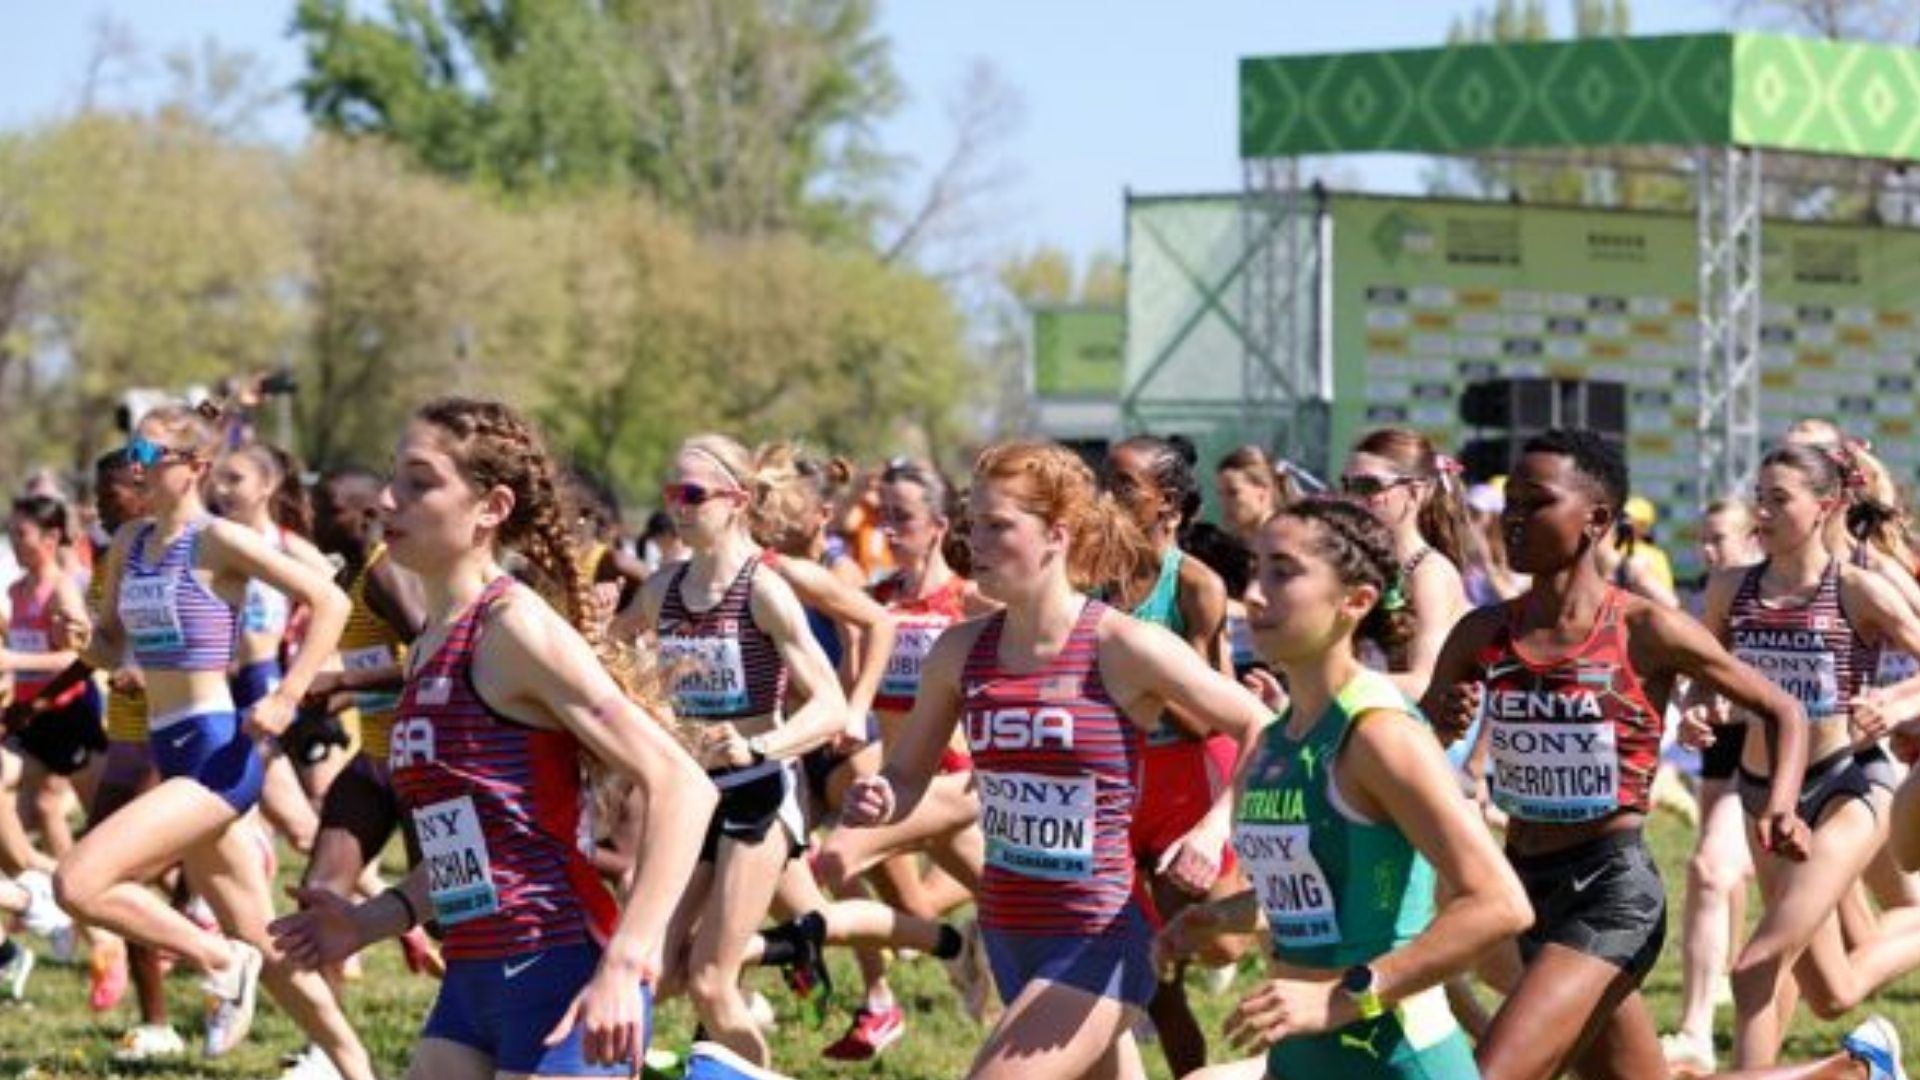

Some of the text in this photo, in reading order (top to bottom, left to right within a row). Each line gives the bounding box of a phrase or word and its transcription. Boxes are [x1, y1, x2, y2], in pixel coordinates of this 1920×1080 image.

[1735, 631, 1826, 649] CANADA
[1487, 689, 1603, 719] KENYA
[967, 707, 1075, 750] USA
[1493, 728, 1598, 754] SONY
[983, 776, 1081, 806] SONY
[1496, 759, 1612, 798] CHEROTICH
[984, 805, 1084, 849] DALTON
[1266, 873, 1324, 911] JONG
